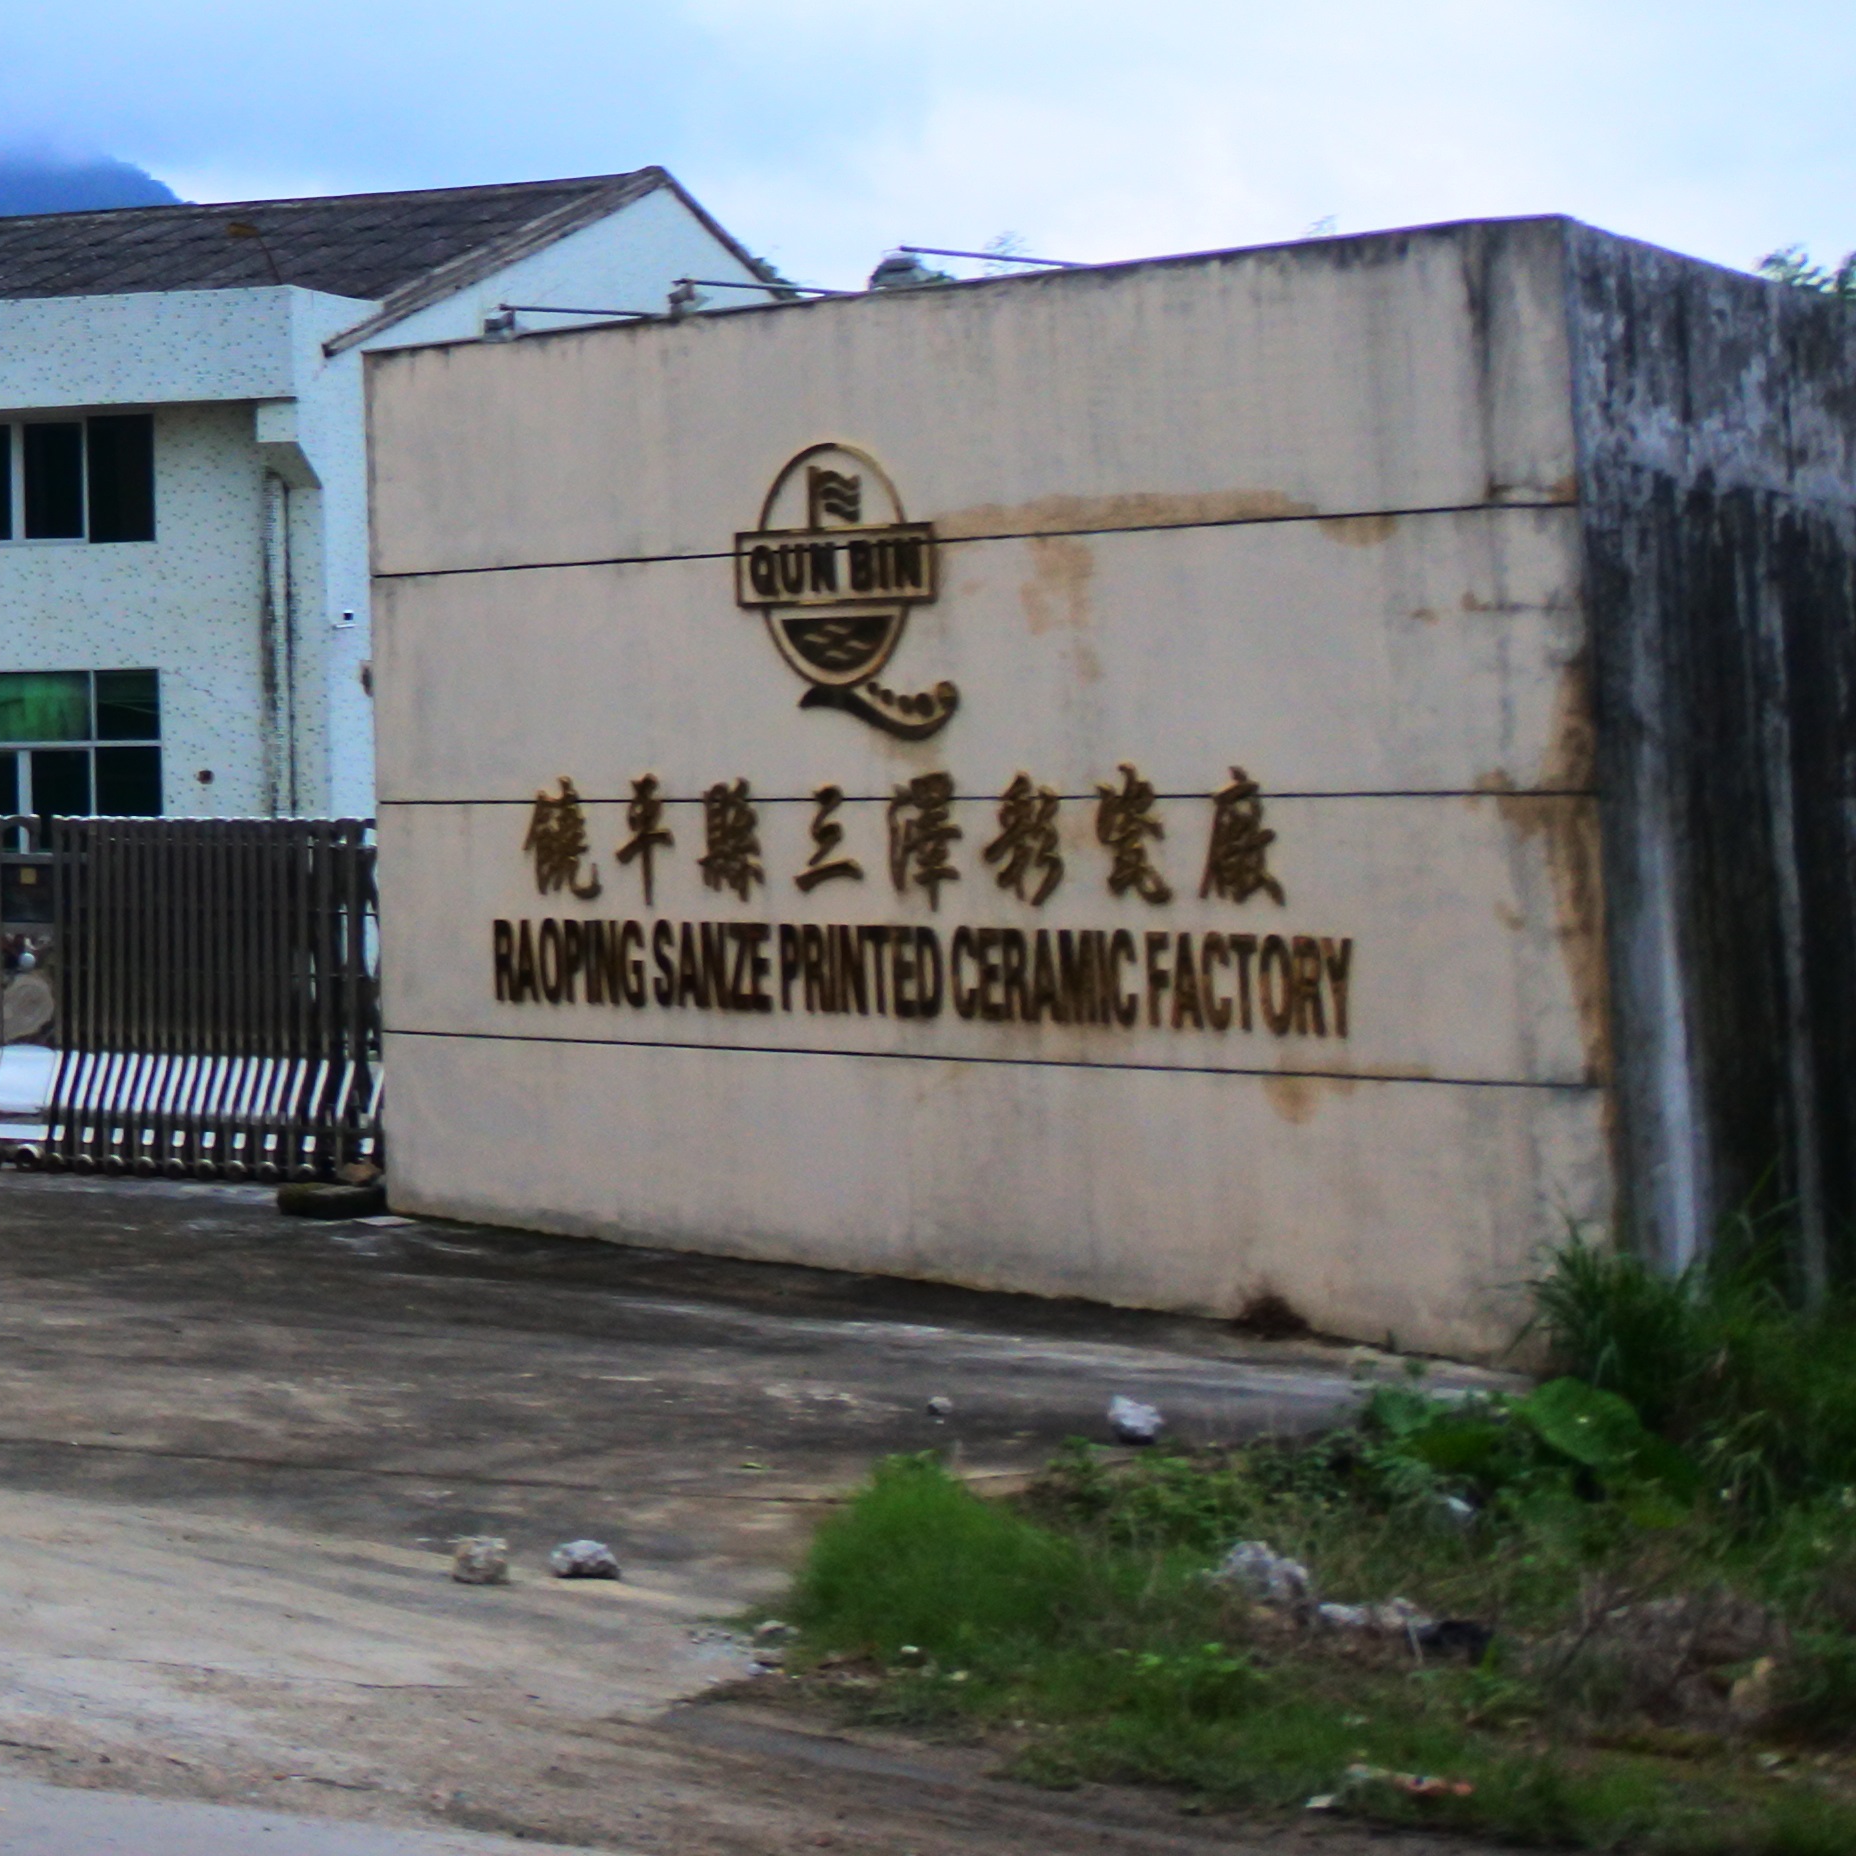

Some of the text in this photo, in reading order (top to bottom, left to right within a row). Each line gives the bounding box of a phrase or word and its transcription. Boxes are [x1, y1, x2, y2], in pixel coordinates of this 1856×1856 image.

[751, 536, 923, 596] QUN BIN
[493, 918, 1353, 1039] RAOPING SANZE PRINTED CERAMIC FACTORY
